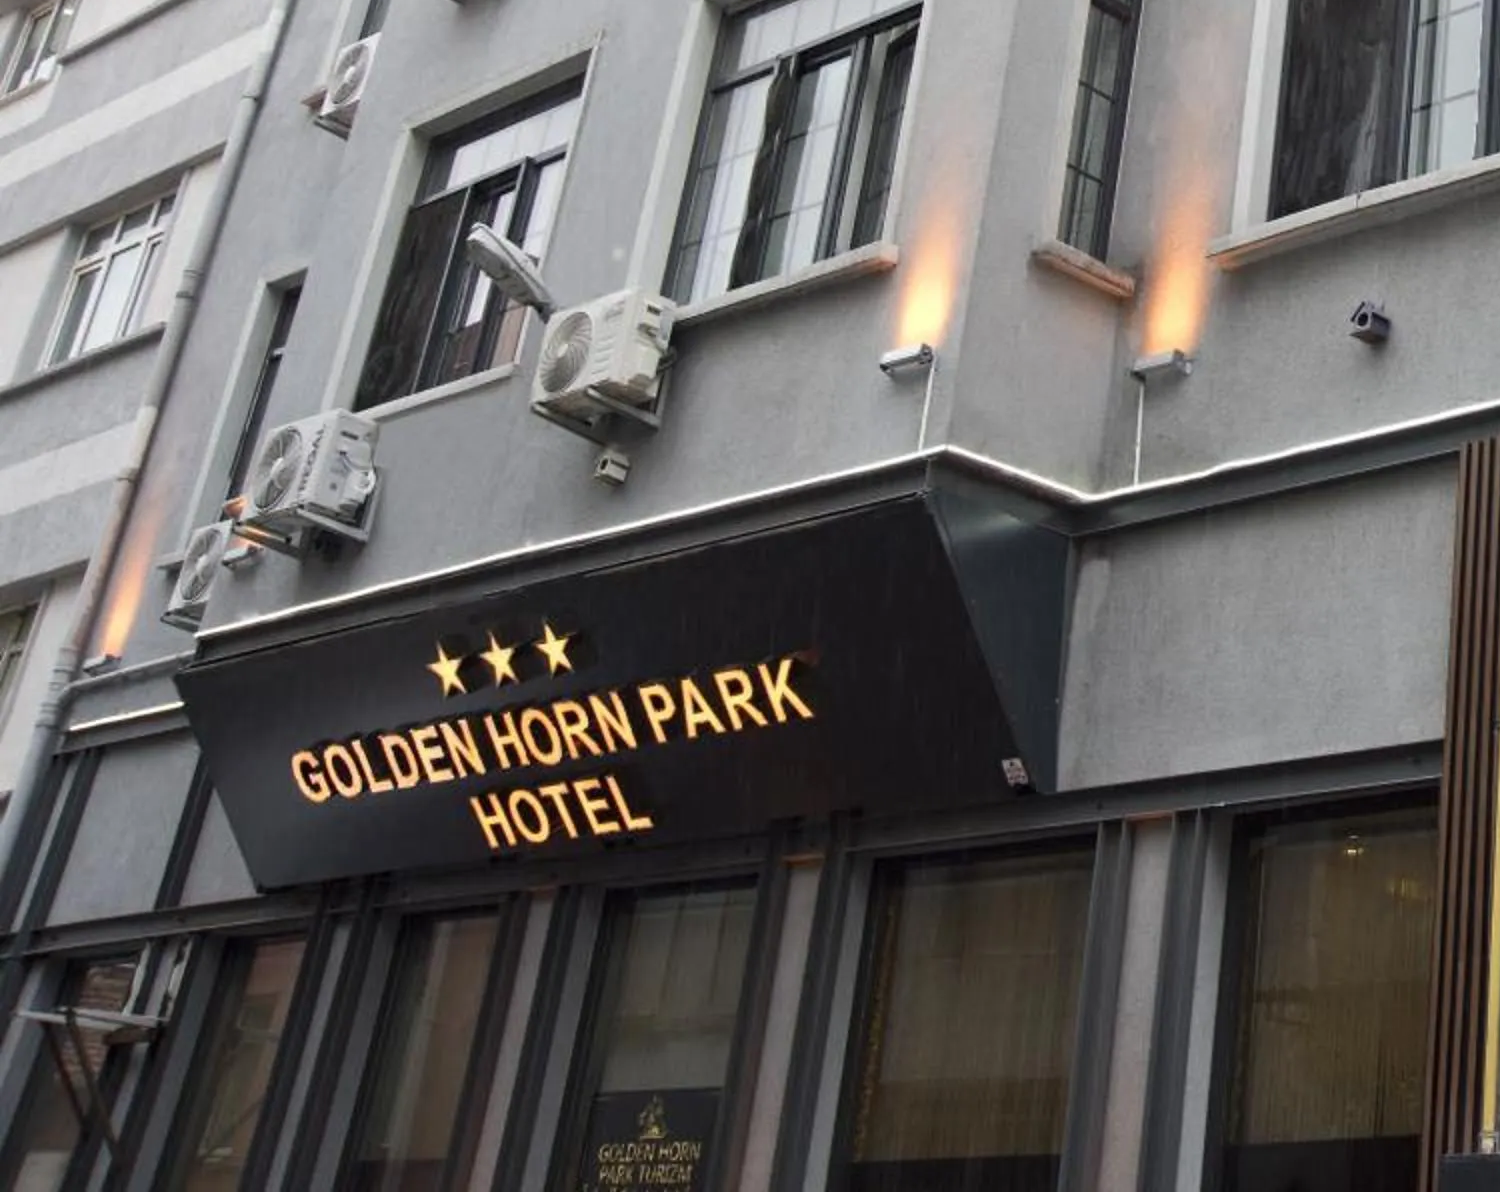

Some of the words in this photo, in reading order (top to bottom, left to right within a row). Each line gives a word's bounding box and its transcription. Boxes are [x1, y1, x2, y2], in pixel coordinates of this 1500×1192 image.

[291, 719, 486, 803] GOLDEN
[484, 691, 638, 769] HORN
[639, 658, 814, 744] PARK
[469, 776, 654, 848] HOTEL
[598, 1142, 656, 1163] GOLDEN
[658, 1141, 702, 1162] HORN
